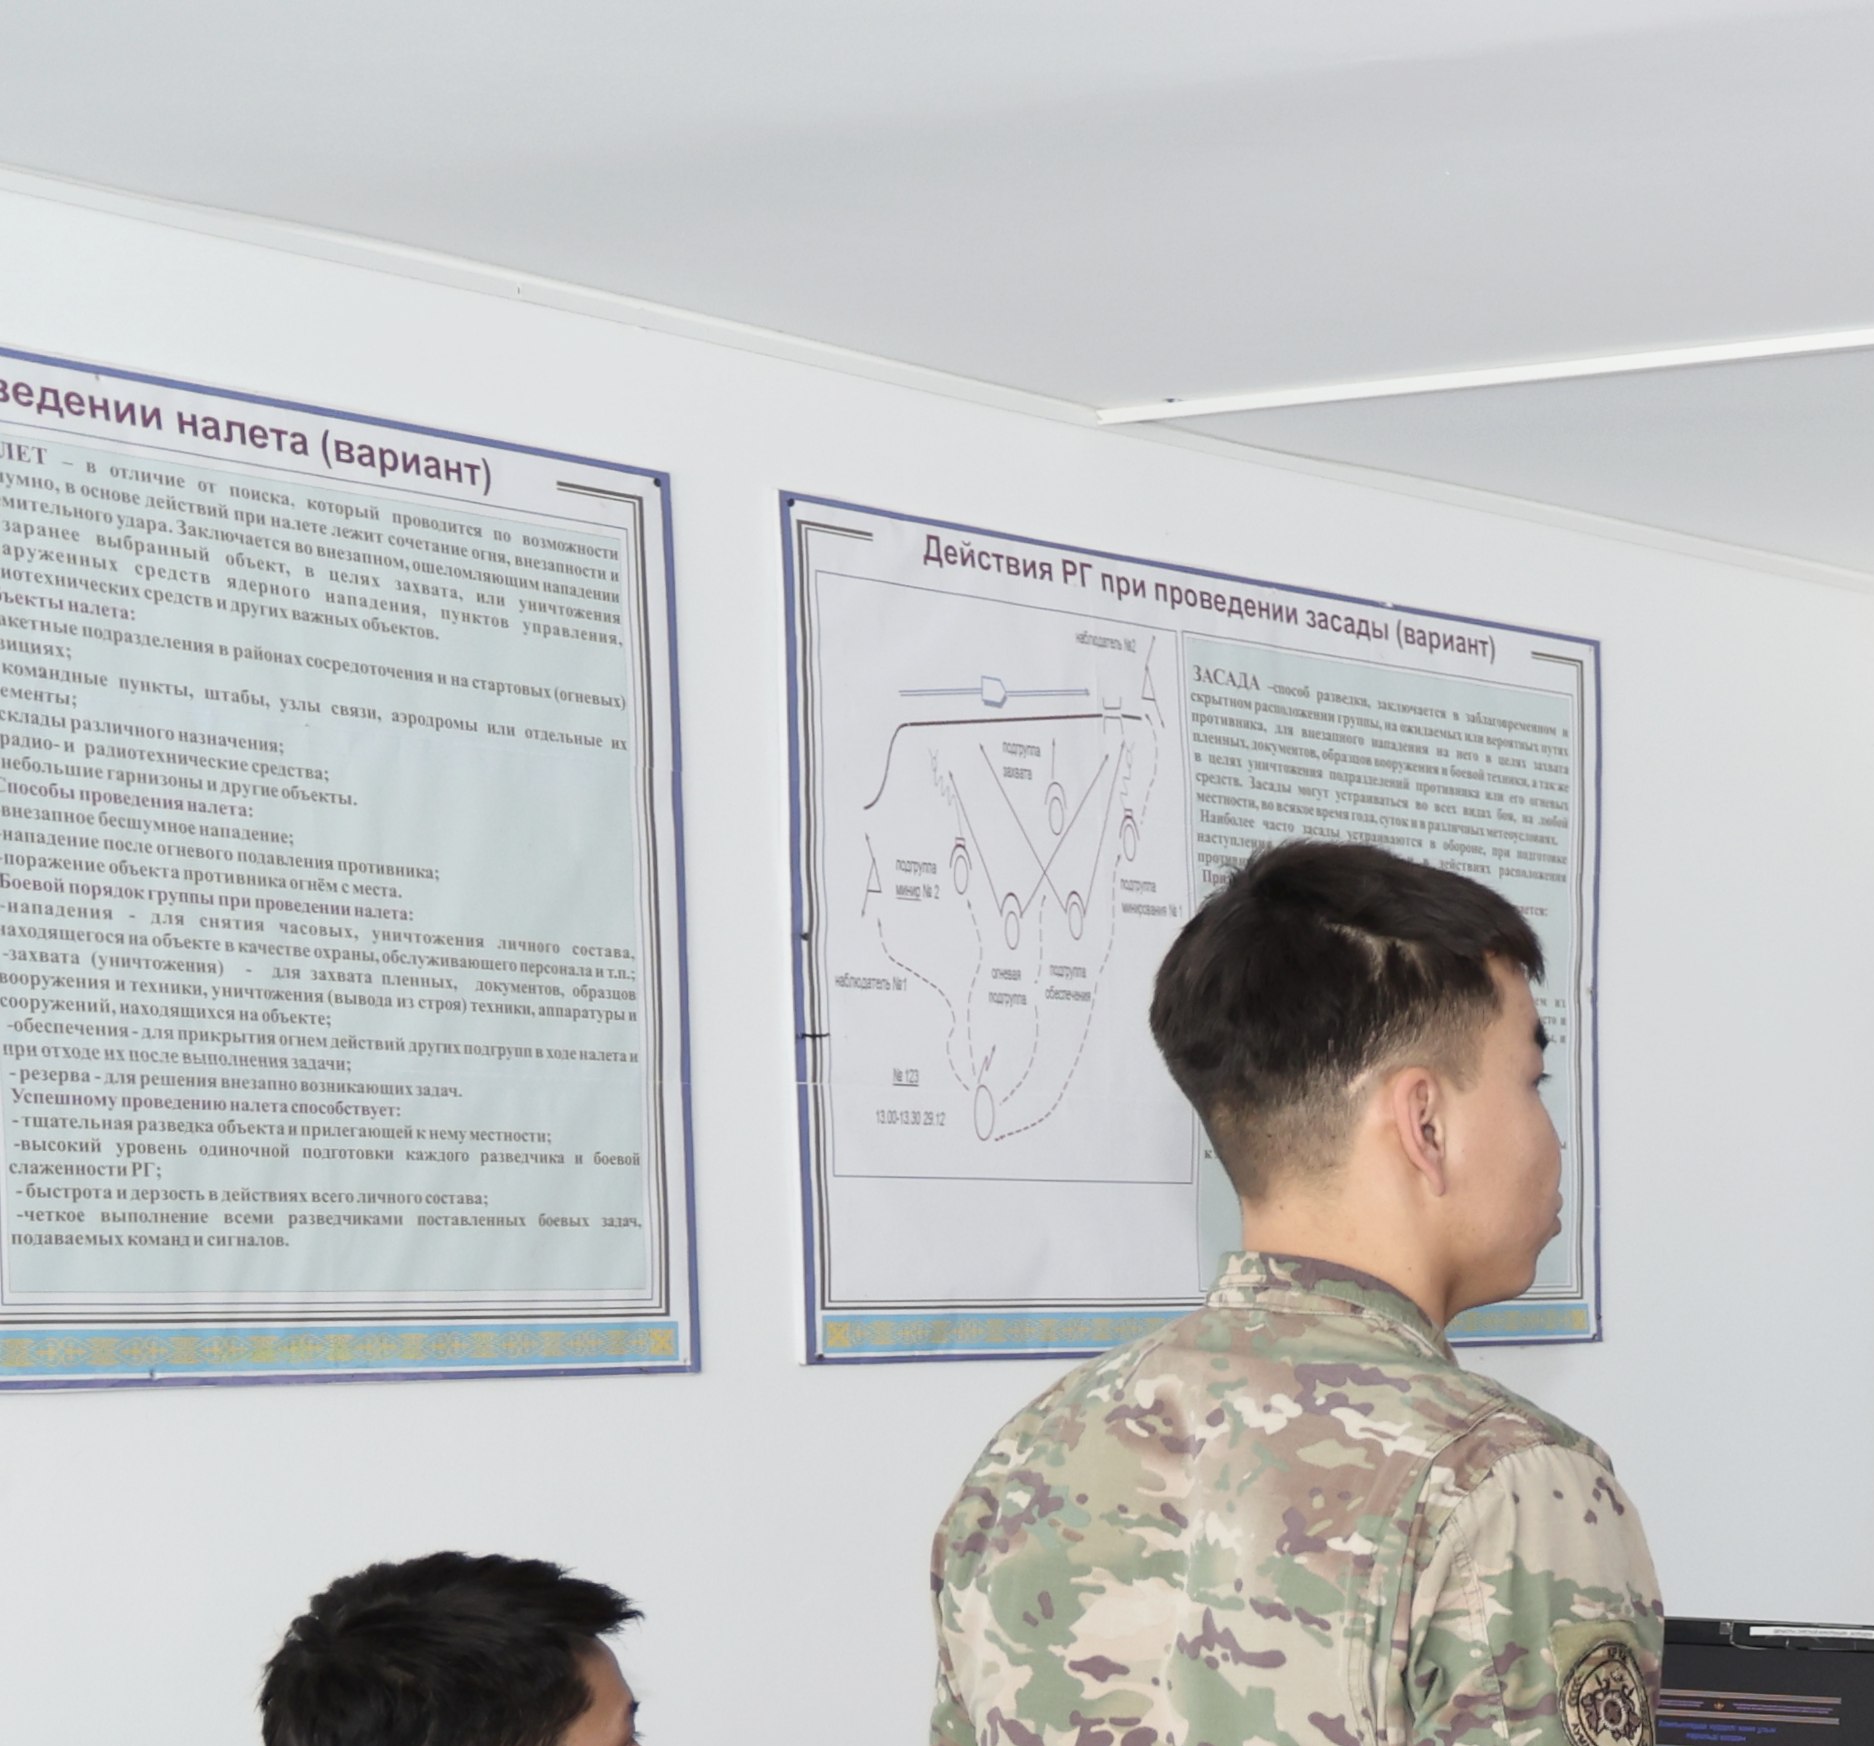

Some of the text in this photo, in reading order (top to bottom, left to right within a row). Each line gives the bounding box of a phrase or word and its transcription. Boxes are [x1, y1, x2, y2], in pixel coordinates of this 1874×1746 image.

[177, 411, 309, 457] налета
[322, 429, 491, 496] (вариант)
[65, 481, 619, 583] в основе действий при налете лежит сочетание огня, внезапности и
[86, 462, 618, 561] в отличие от поиска, который проводится по возможности
[3, 520, 621, 625] заранее выбранный объект, в целях захвата, или уничтожения
[135, 563, 623, 648] средств ядерного нападения, пунктов управления,
[923, 534, 1495, 665] Действия РГ при проведении засады (вариант)
[1193, 664, 1261, 691] ЗАСАДА
[0, 872, 413, 922] Боевой порядок группы при проведении налета:
[12, 1087, 400, 1121] Успешному проведению налета способствует:
[9, 1163, 127, 1177] слаженности
[116, 1142, 187, 1159] уровень
[199, 1143, 289, 1158] одиночной
[303, 1147, 393, 1161] подготовки
[12, 1233, 123, 1246] подаваемых
[128, 1234, 190, 1247] команд
